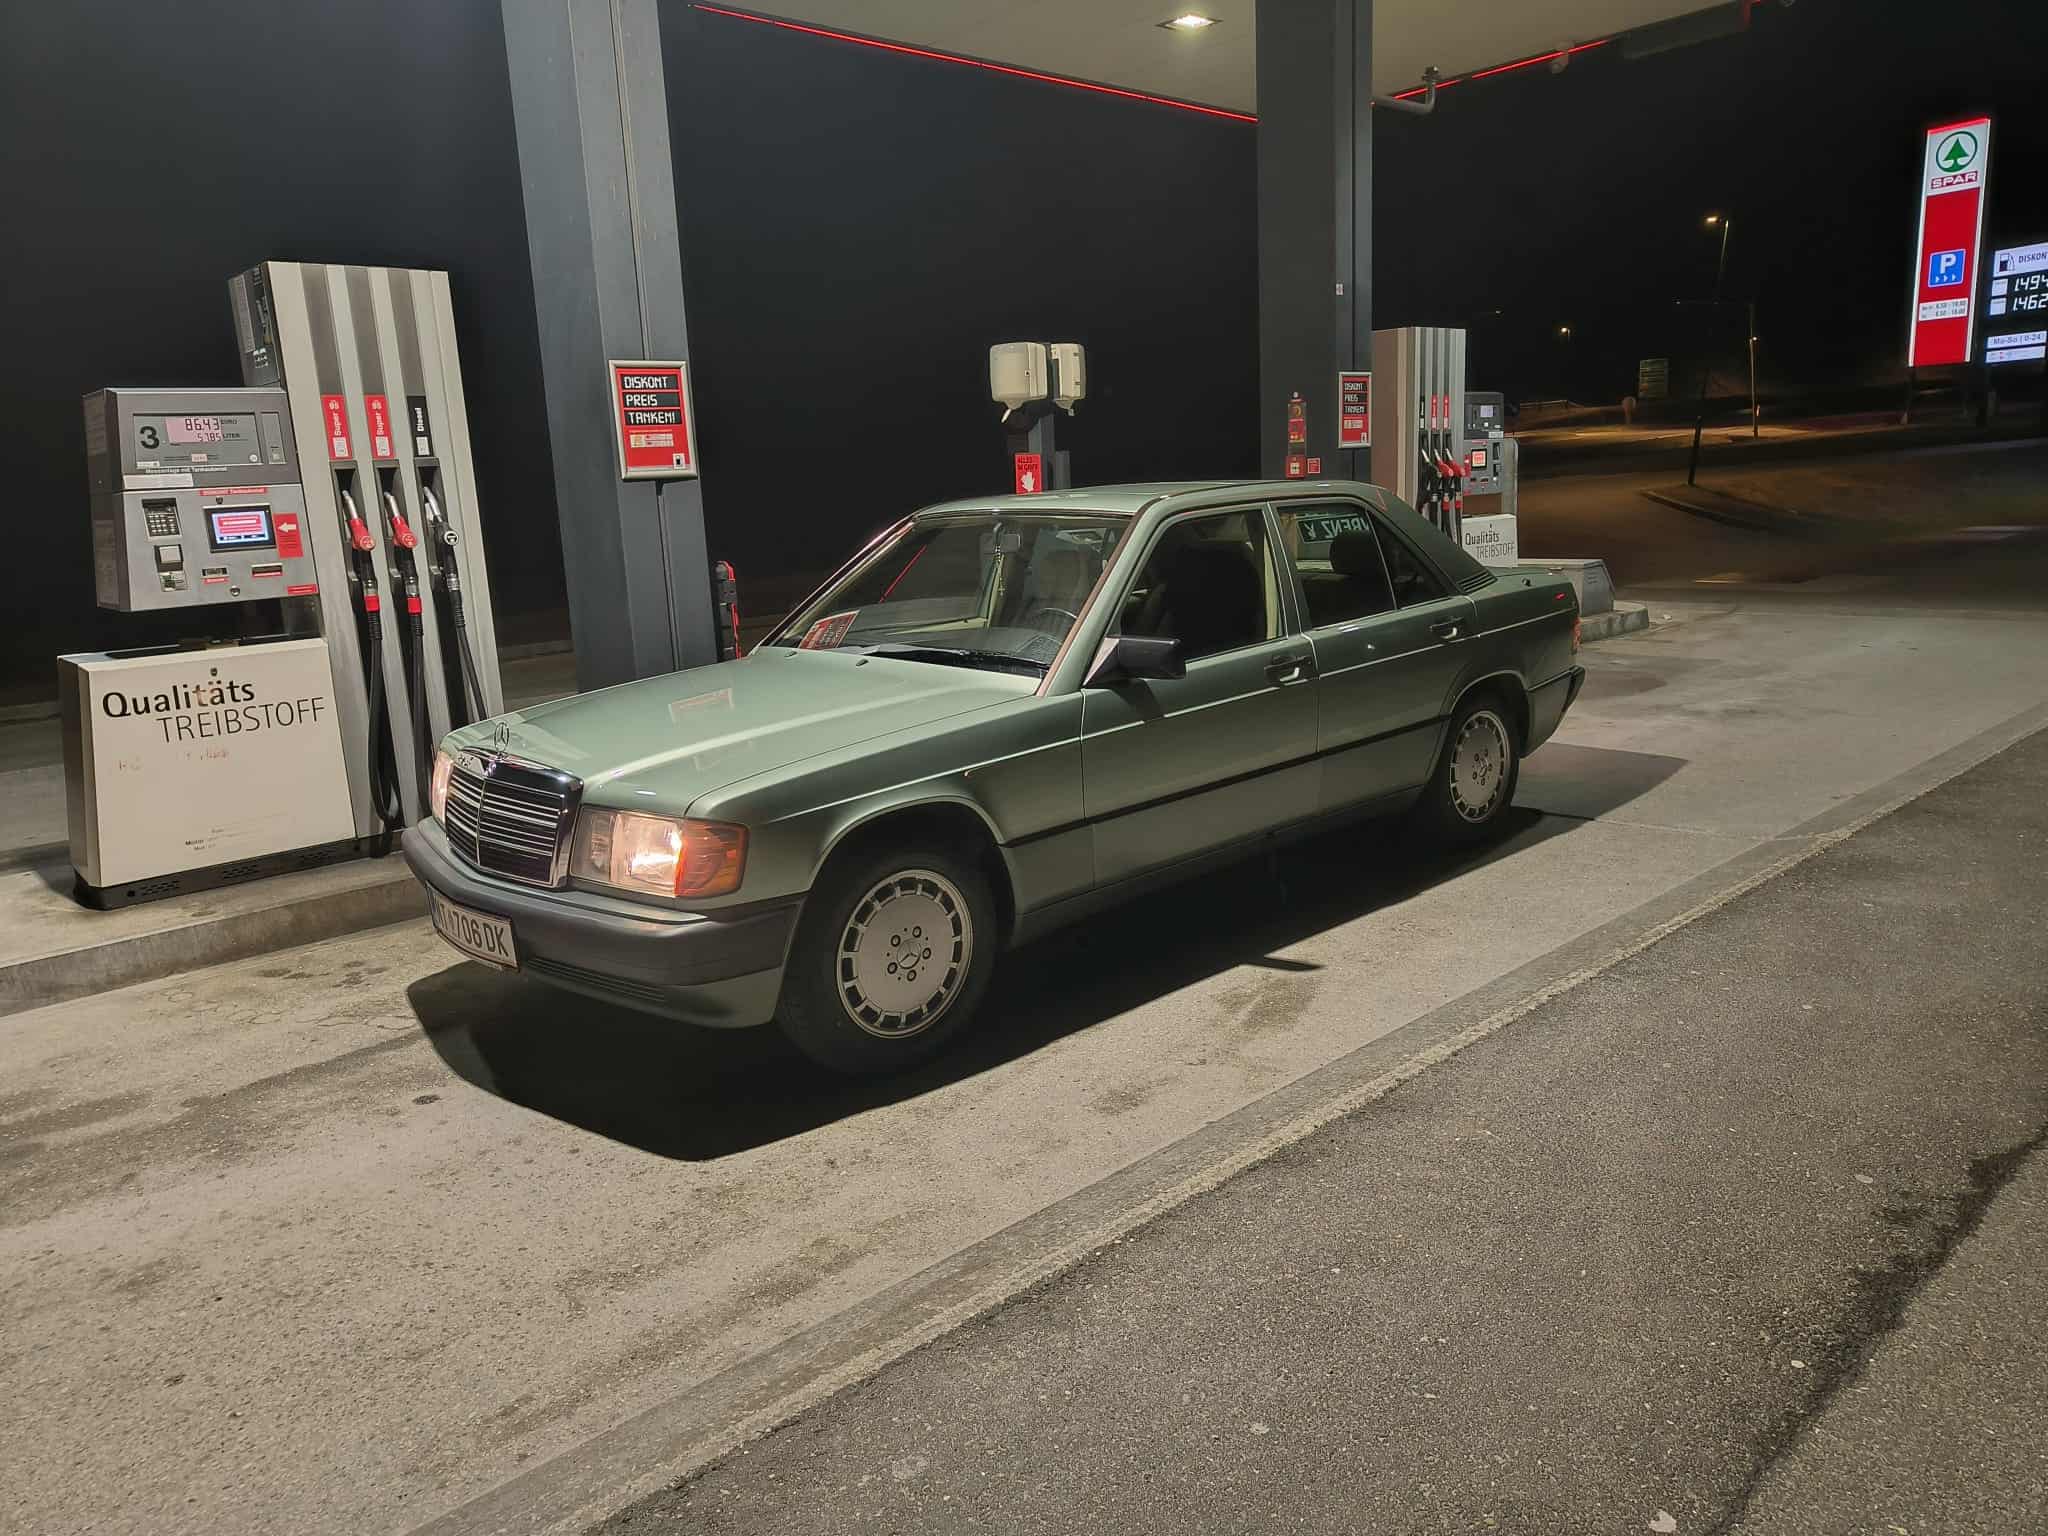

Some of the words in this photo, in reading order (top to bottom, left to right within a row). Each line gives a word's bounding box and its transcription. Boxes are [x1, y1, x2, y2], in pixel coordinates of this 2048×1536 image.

[1932, 172, 1977, 188] SPAR
[1940, 253, 1957, 273] P
[623, 376, 668, 389] DISKONT
[626, 394, 658, 406] PREIS
[333, 410, 342, 436] Super
[375, 410, 384, 436] Super
[414, 407, 425, 431] Diesel
[628, 411, 676, 424] TANKEN!
[139, 426, 160, 449] 3
[1465, 530, 1500, 546] Qualitäts
[1475, 542, 1515, 559] TREIBSTOFF
[102, 679, 255, 718] Qualitäts
[156, 696, 325, 743] TREIBSTOFF
